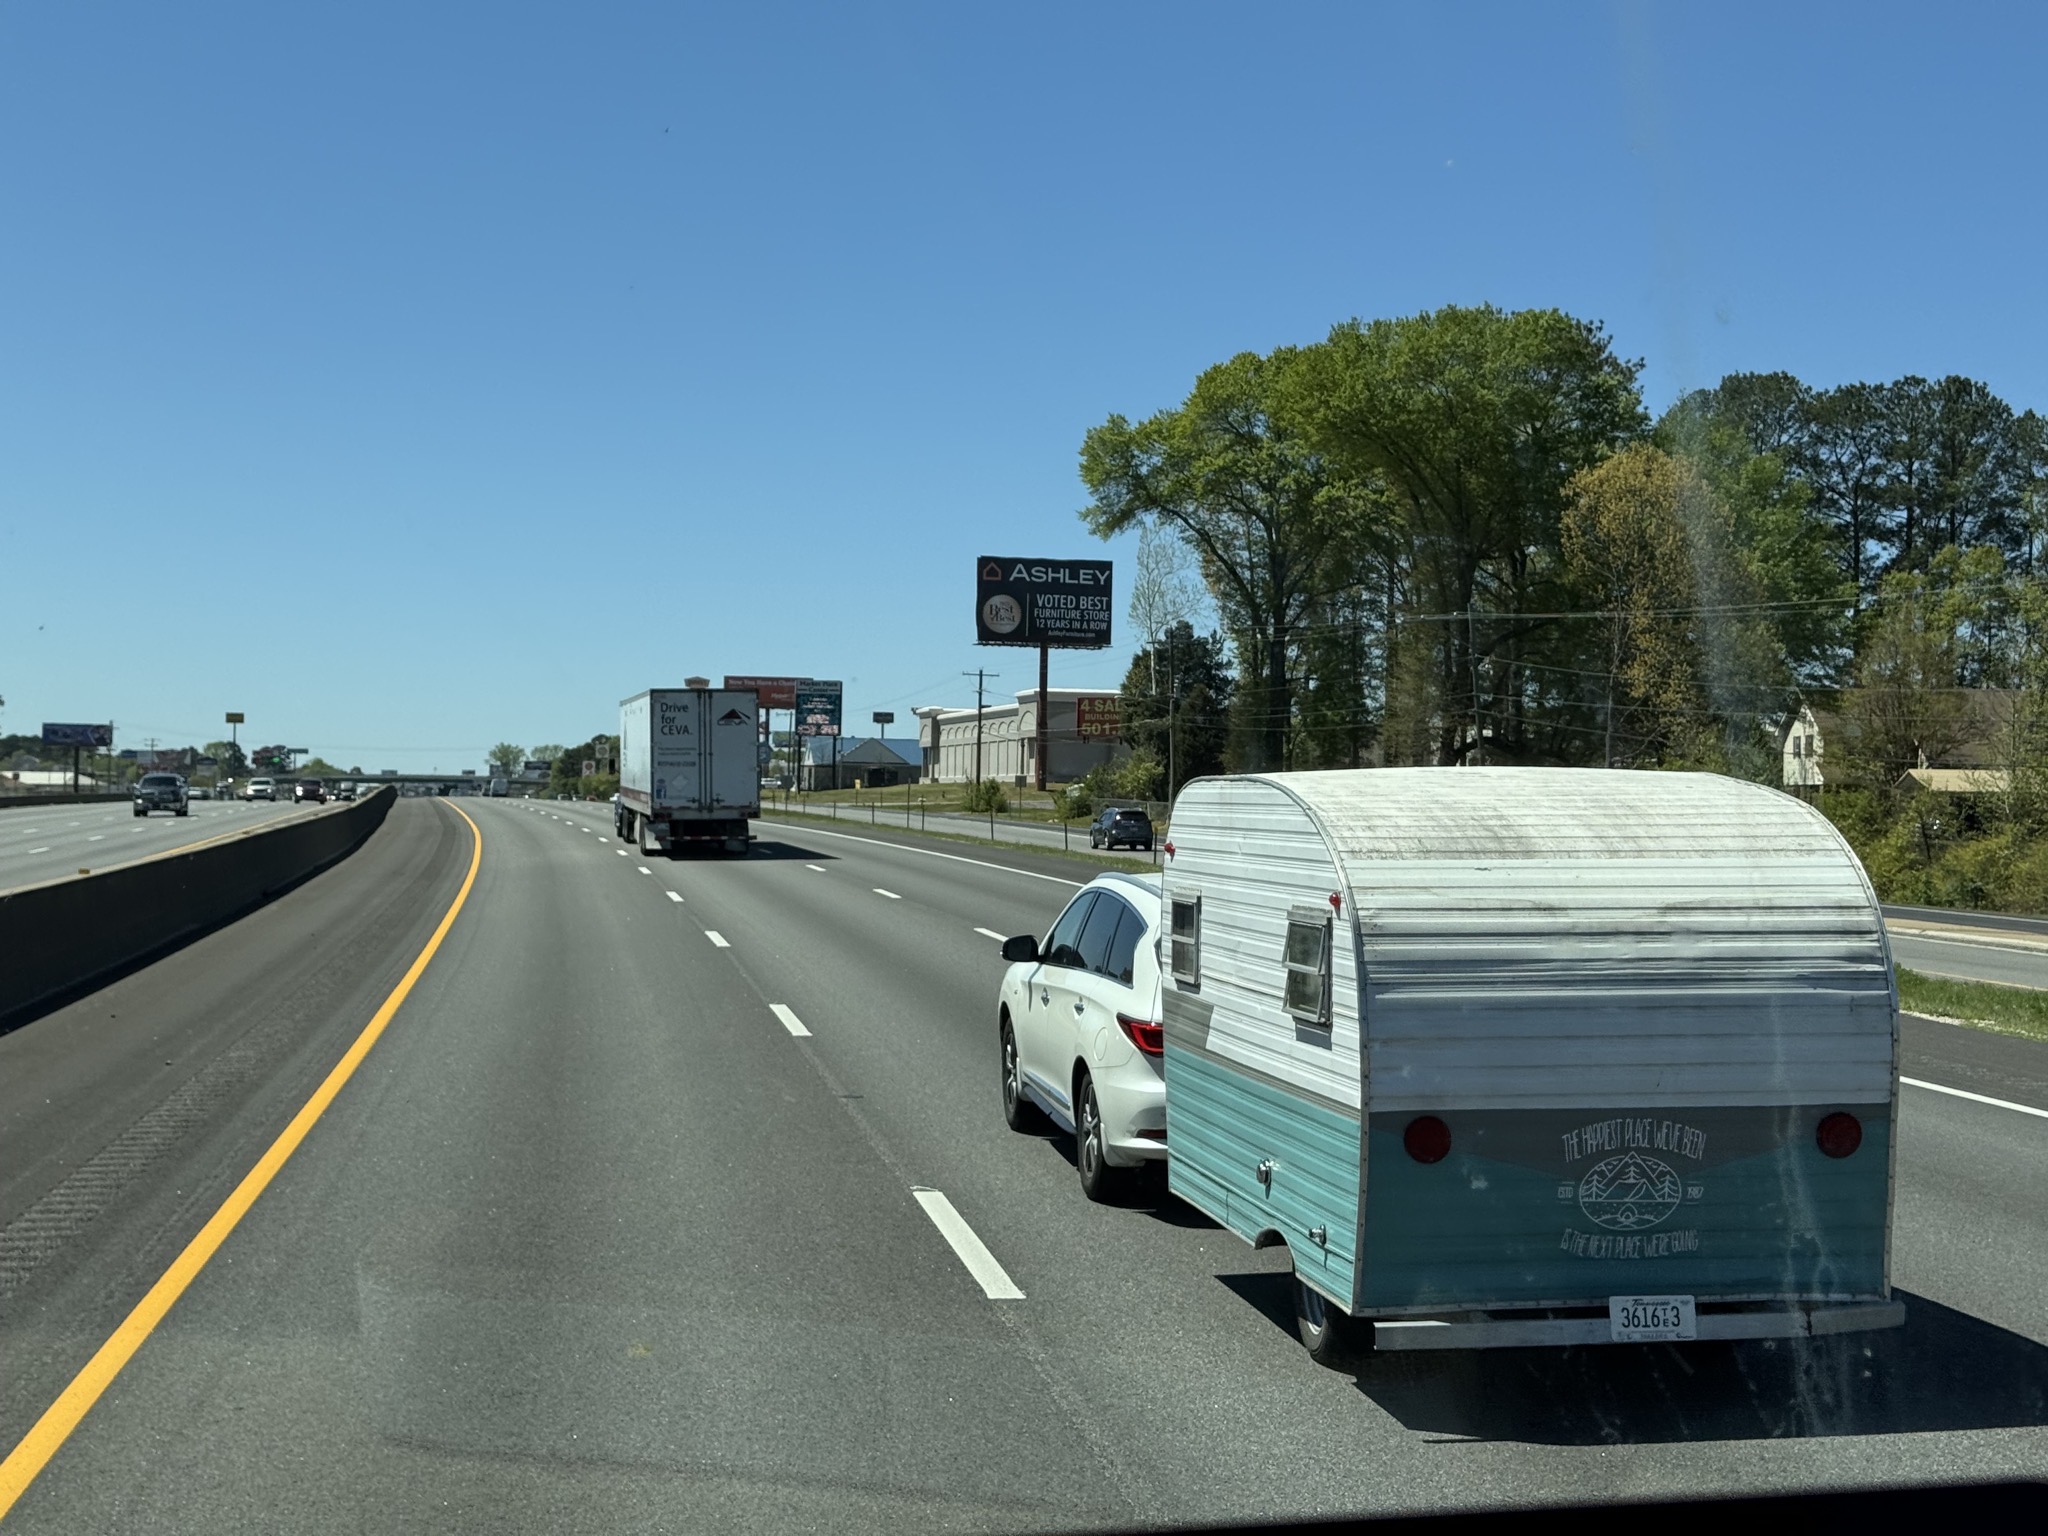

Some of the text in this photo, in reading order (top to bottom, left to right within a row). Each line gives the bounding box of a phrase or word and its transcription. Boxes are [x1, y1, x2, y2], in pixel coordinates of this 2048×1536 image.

[1009, 563, 1111, 585] ASHLEY
[1036, 593, 1109, 610] VOTED BEST
[1034, 608, 1110, 621] FURNITURE STORE
[1035, 618, 1108, 631] 12 YEARS IN A ROW
[660, 702, 689, 713] Drive
[1080, 699, 1123, 712] 4 SAL
[661, 713, 676, 724] for
[1084, 713, 1120, 721] BUILDIN
[1081, 722, 1118, 735] 501.
[1561, 1129, 1581, 1163] THE
[1581, 1118, 1623, 1155] HAPPIEST
[1624, 1118, 1653, 1148] PLACE
[1682, 1126, 1707, 1161] BEEN
[1569, 1230, 1590, 1257] THE
[1587, 1234, 1613, 1258] NEXT
